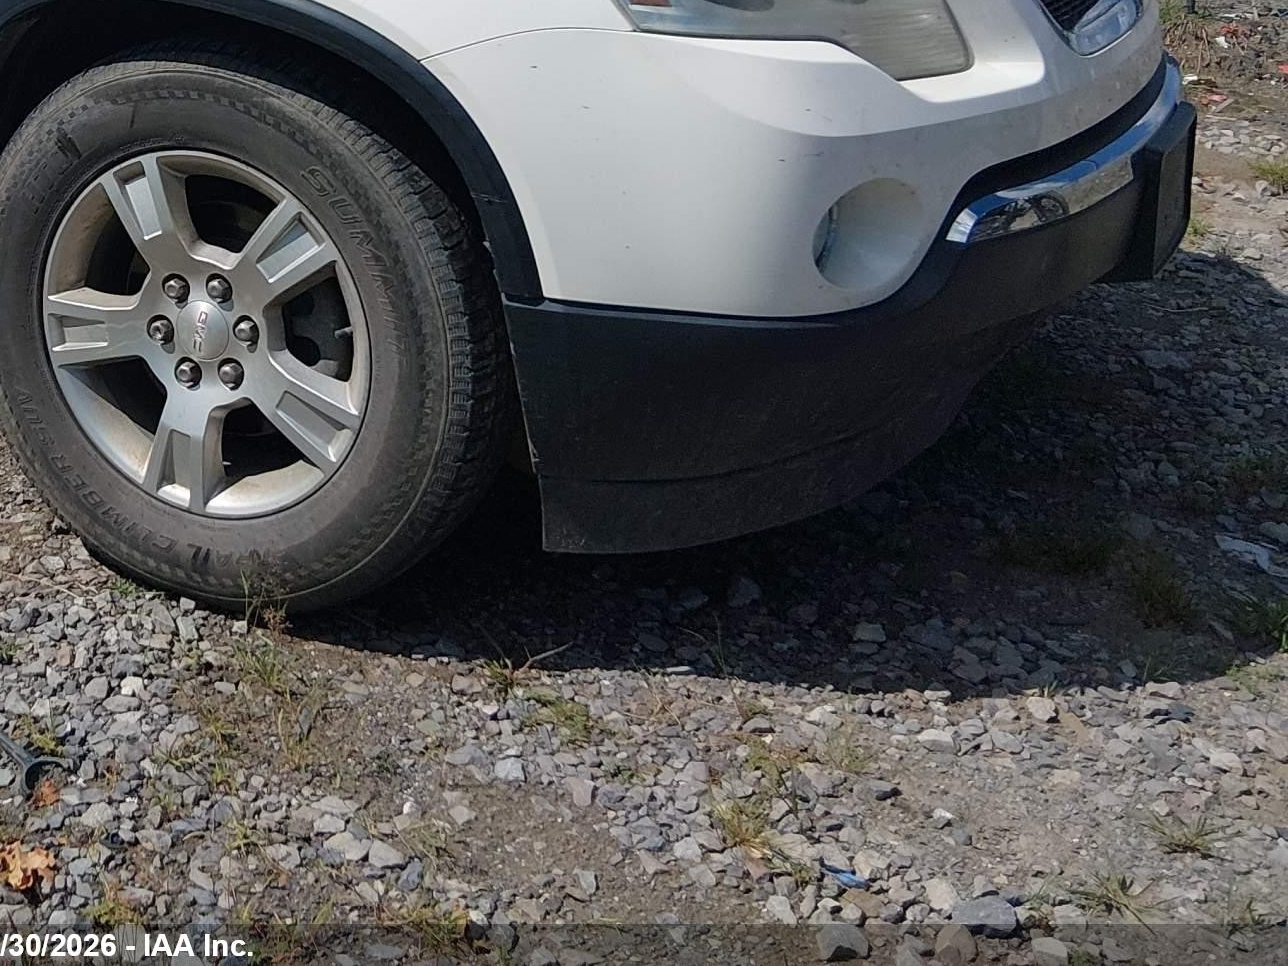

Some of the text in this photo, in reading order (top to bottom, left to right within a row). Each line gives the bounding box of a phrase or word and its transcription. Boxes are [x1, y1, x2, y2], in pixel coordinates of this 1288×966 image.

[299, 166, 407, 364] SUMMIT
[191, 310, 209, 354] GMC
[49, 453, 178, 552] CLIMBER
